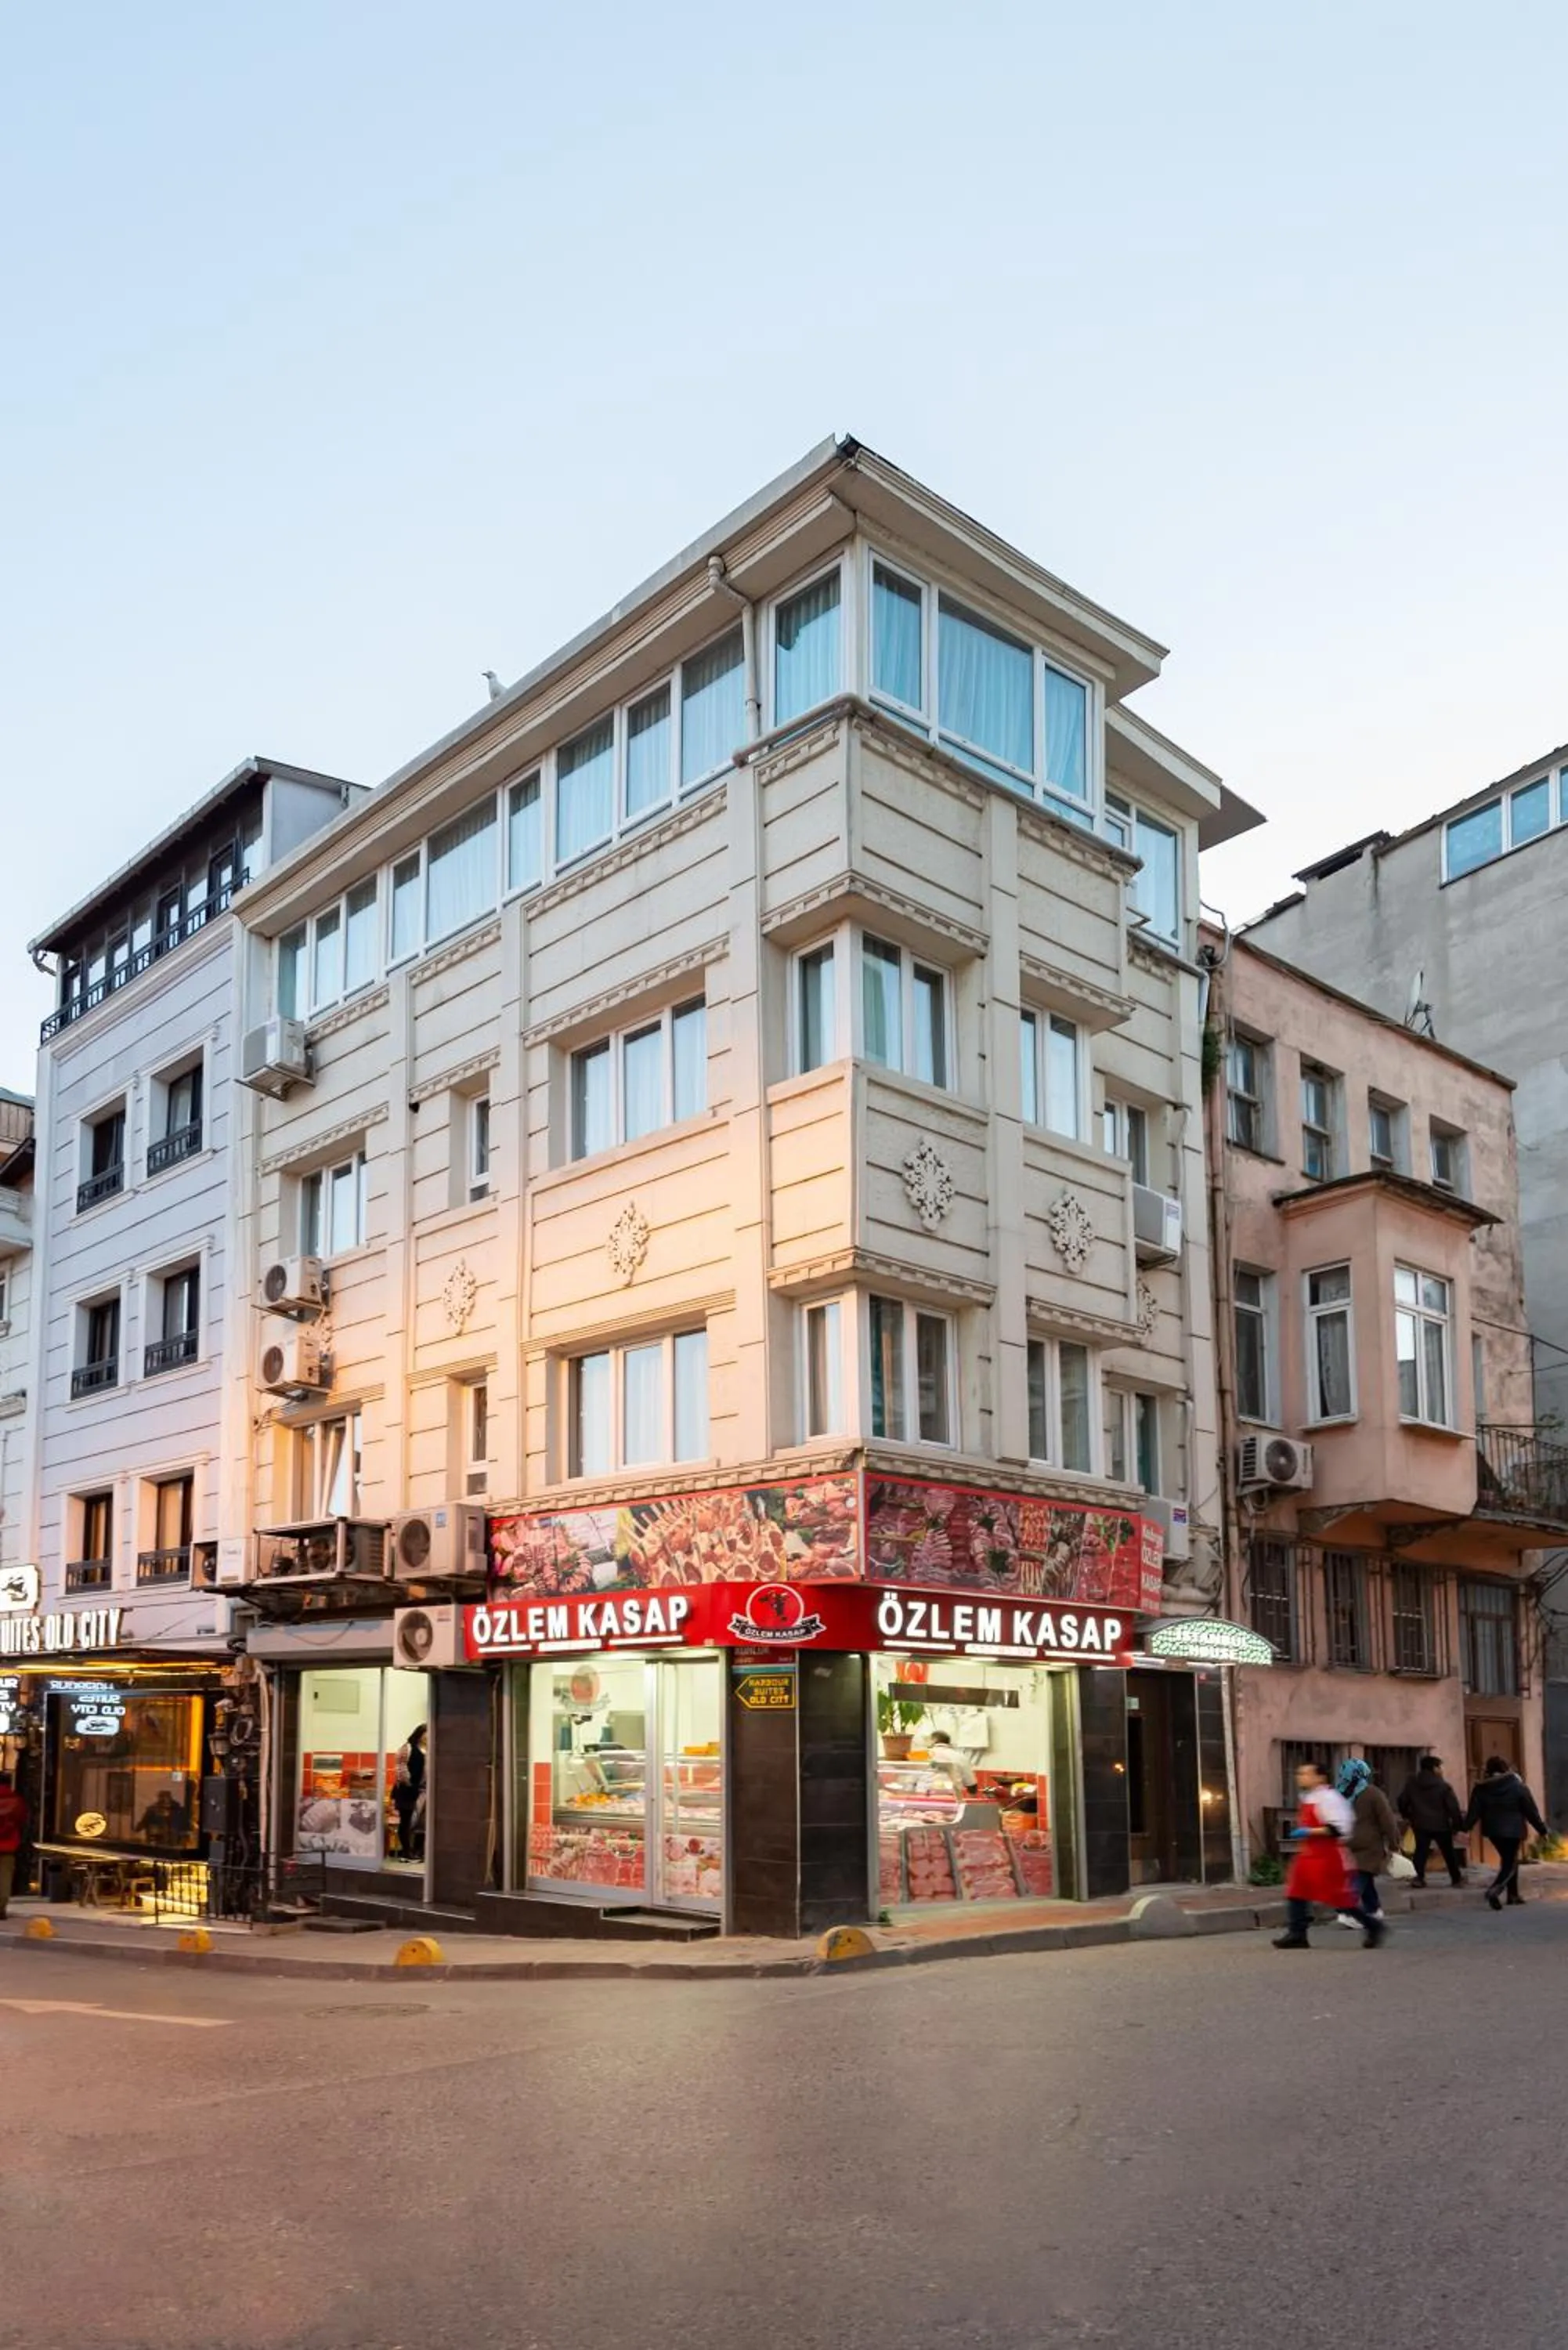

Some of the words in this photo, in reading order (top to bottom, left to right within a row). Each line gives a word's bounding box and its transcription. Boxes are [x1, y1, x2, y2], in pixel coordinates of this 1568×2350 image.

[0, 1617, 39, 1653] UITES
[45, 1613, 74, 1650] OLD
[81, 1608, 121, 1647] CITY
[472, 1605, 568, 1644] ÖZLEM
[578, 1596, 688, 1637] KASAP
[745, 1627, 774, 1638] ÖZLEM
[775, 1628, 806, 1638] KASAP
[878, 1591, 1003, 1643] ÖZLEM
[1013, 1610, 1122, 1650] KASAP
[750, 1696, 767, 1705] OLD
[770, 1695, 789, 1705] CITY
